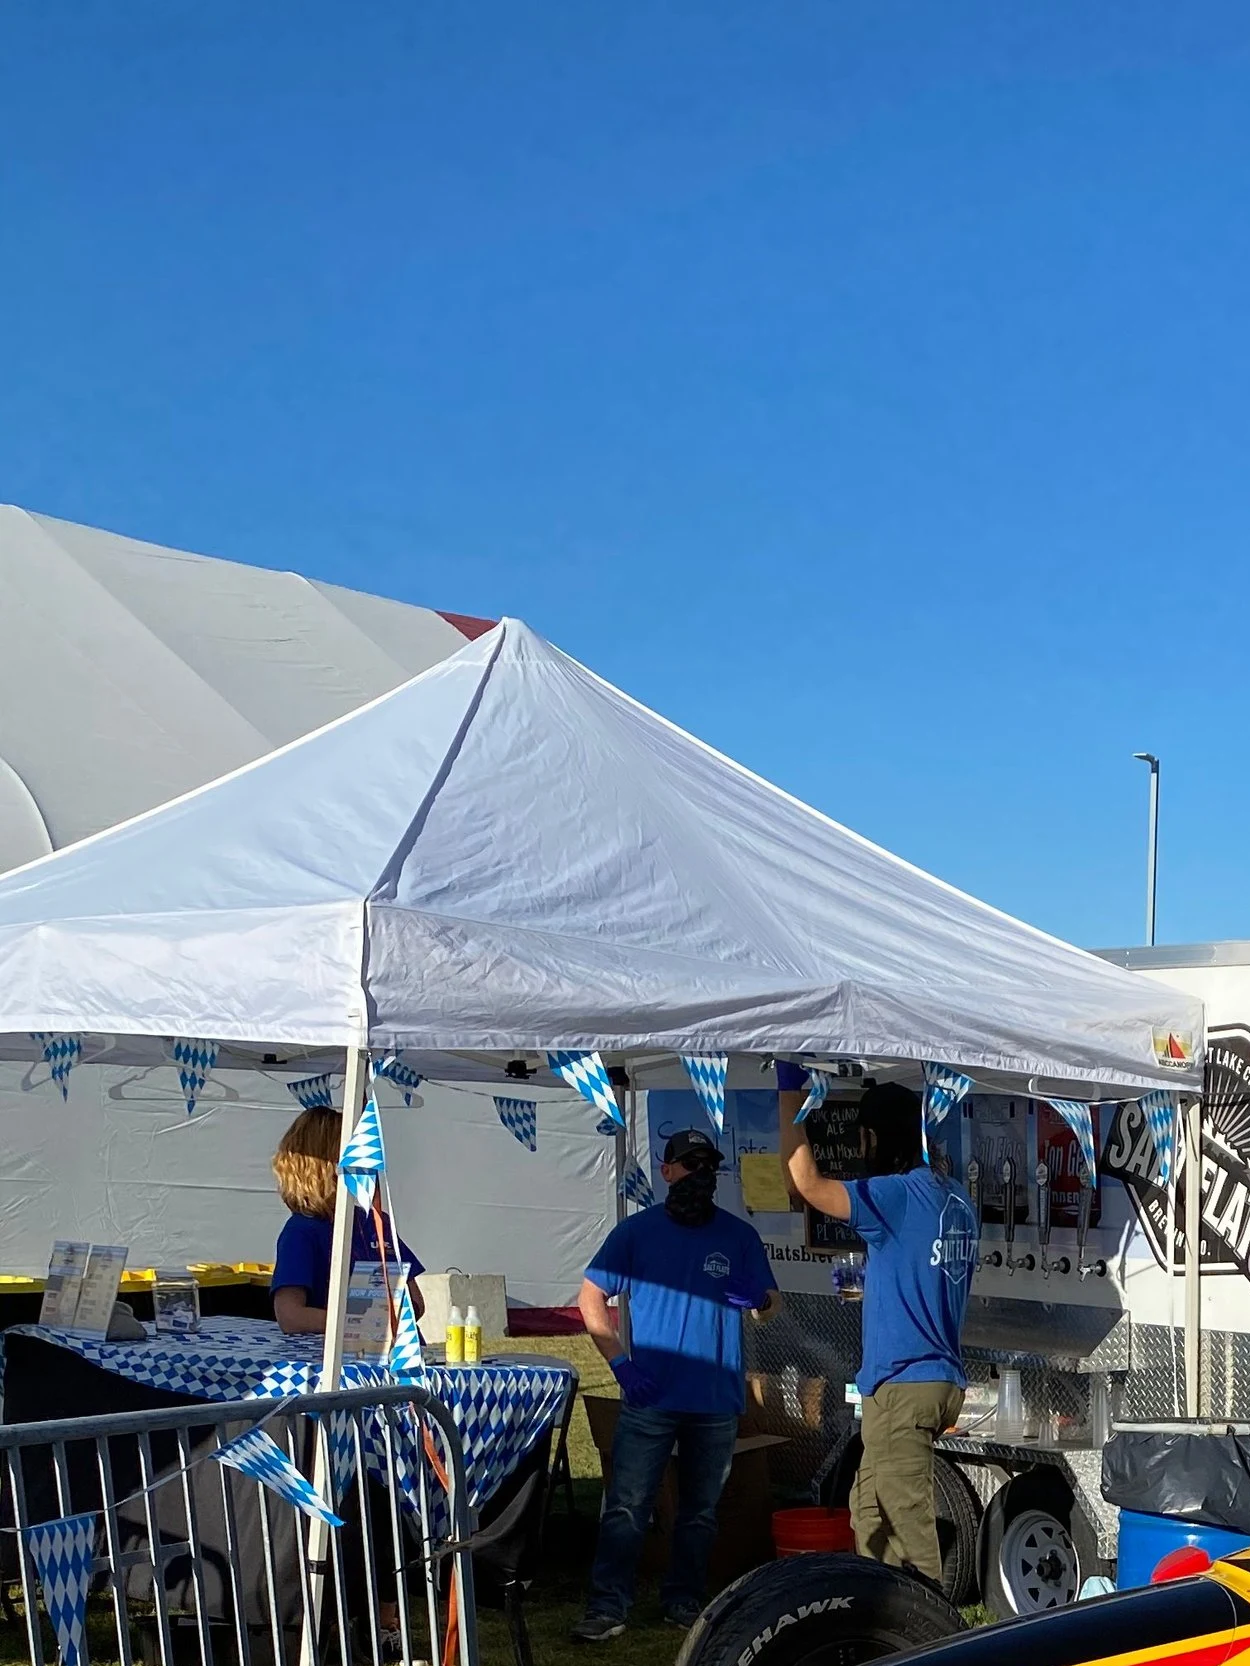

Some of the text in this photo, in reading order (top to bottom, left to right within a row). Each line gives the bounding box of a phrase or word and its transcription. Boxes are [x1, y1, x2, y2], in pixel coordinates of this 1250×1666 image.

[1216, 1047, 1244, 1075] LAKE
[826, 1122, 845, 1137] ALE
[1148, 1199, 1187, 1247] BREIN
